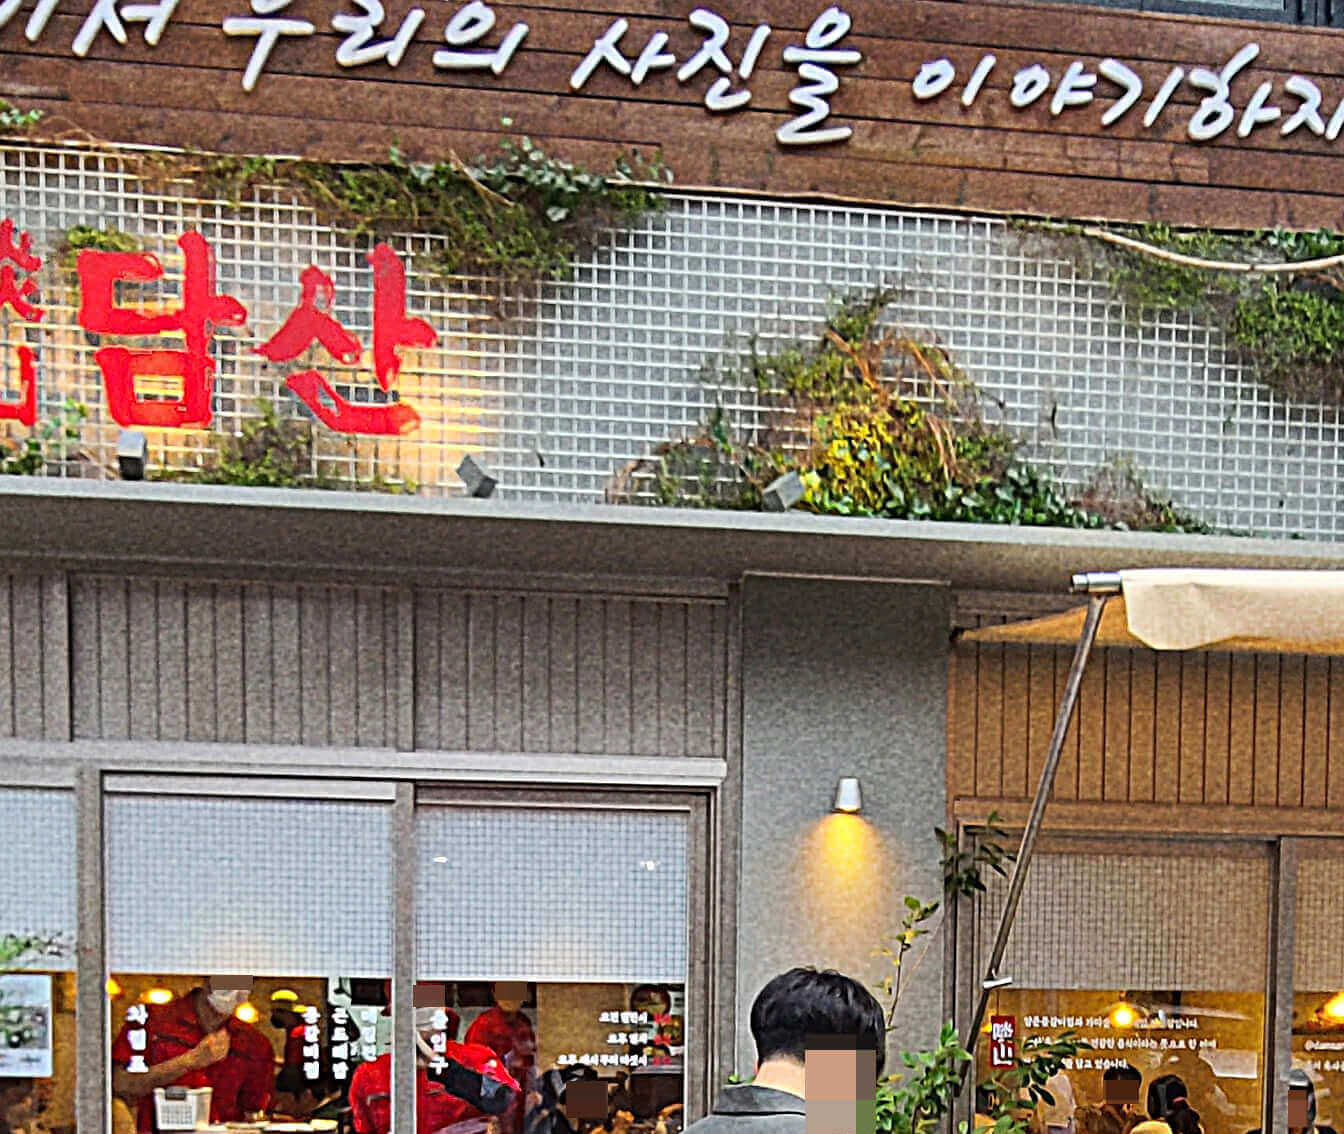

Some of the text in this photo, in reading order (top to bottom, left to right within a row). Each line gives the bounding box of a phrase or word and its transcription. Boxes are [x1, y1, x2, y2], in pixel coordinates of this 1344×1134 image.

[222, 0, 529, 92] 우리의
[569, 7, 862, 146] 사진을
[77, 229, 439, 437] 담산
